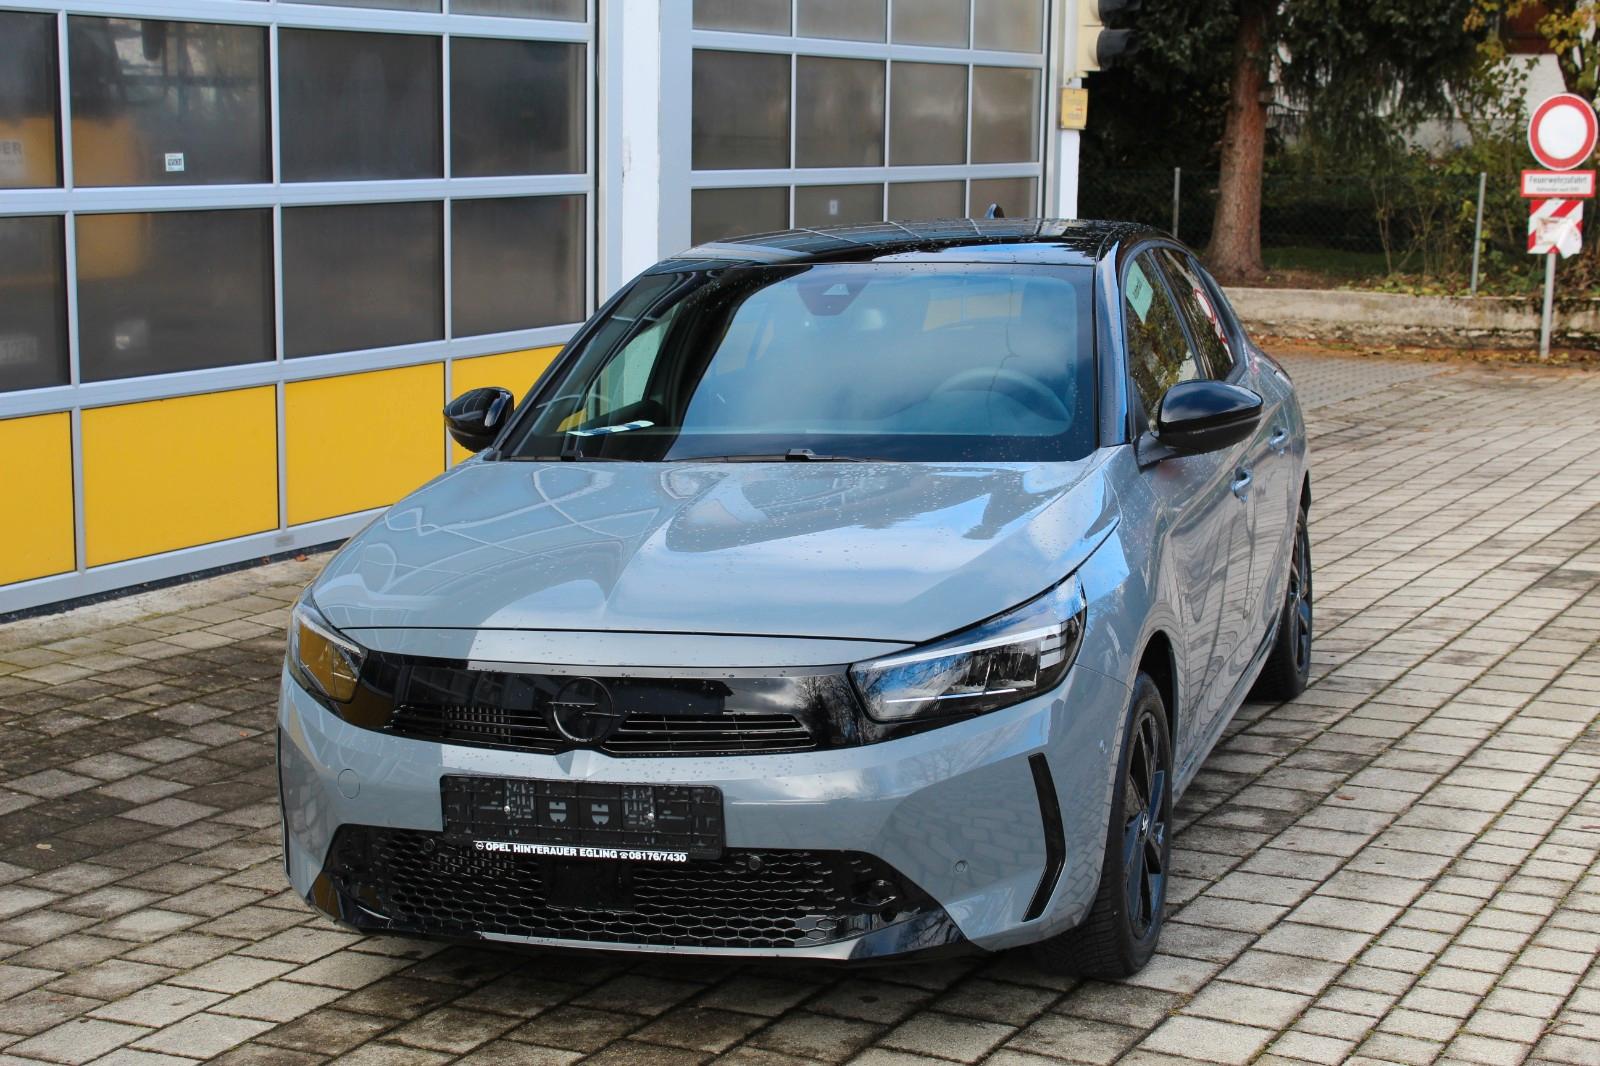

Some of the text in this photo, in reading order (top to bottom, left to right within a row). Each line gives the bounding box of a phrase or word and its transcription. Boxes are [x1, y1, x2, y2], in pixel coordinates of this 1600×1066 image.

[485, 842, 687, 862] OPEL HINTERAUER EGLING 08176/7430
